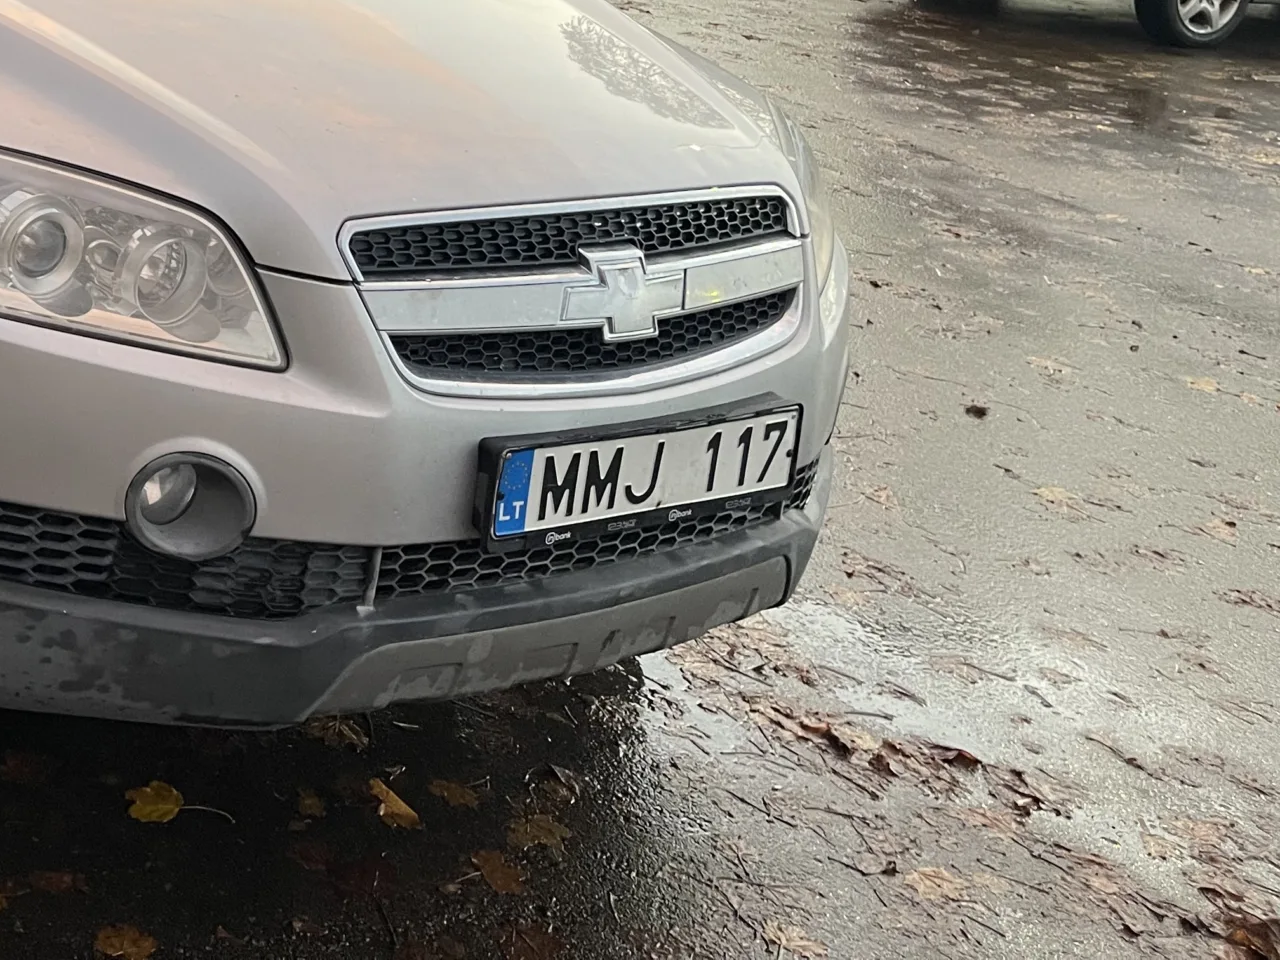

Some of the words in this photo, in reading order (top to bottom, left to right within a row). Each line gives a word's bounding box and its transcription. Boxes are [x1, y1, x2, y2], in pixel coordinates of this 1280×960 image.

[538, 441, 665, 521] MMJ
[706, 421, 788, 492] 117
[498, 501, 524, 521] LT
